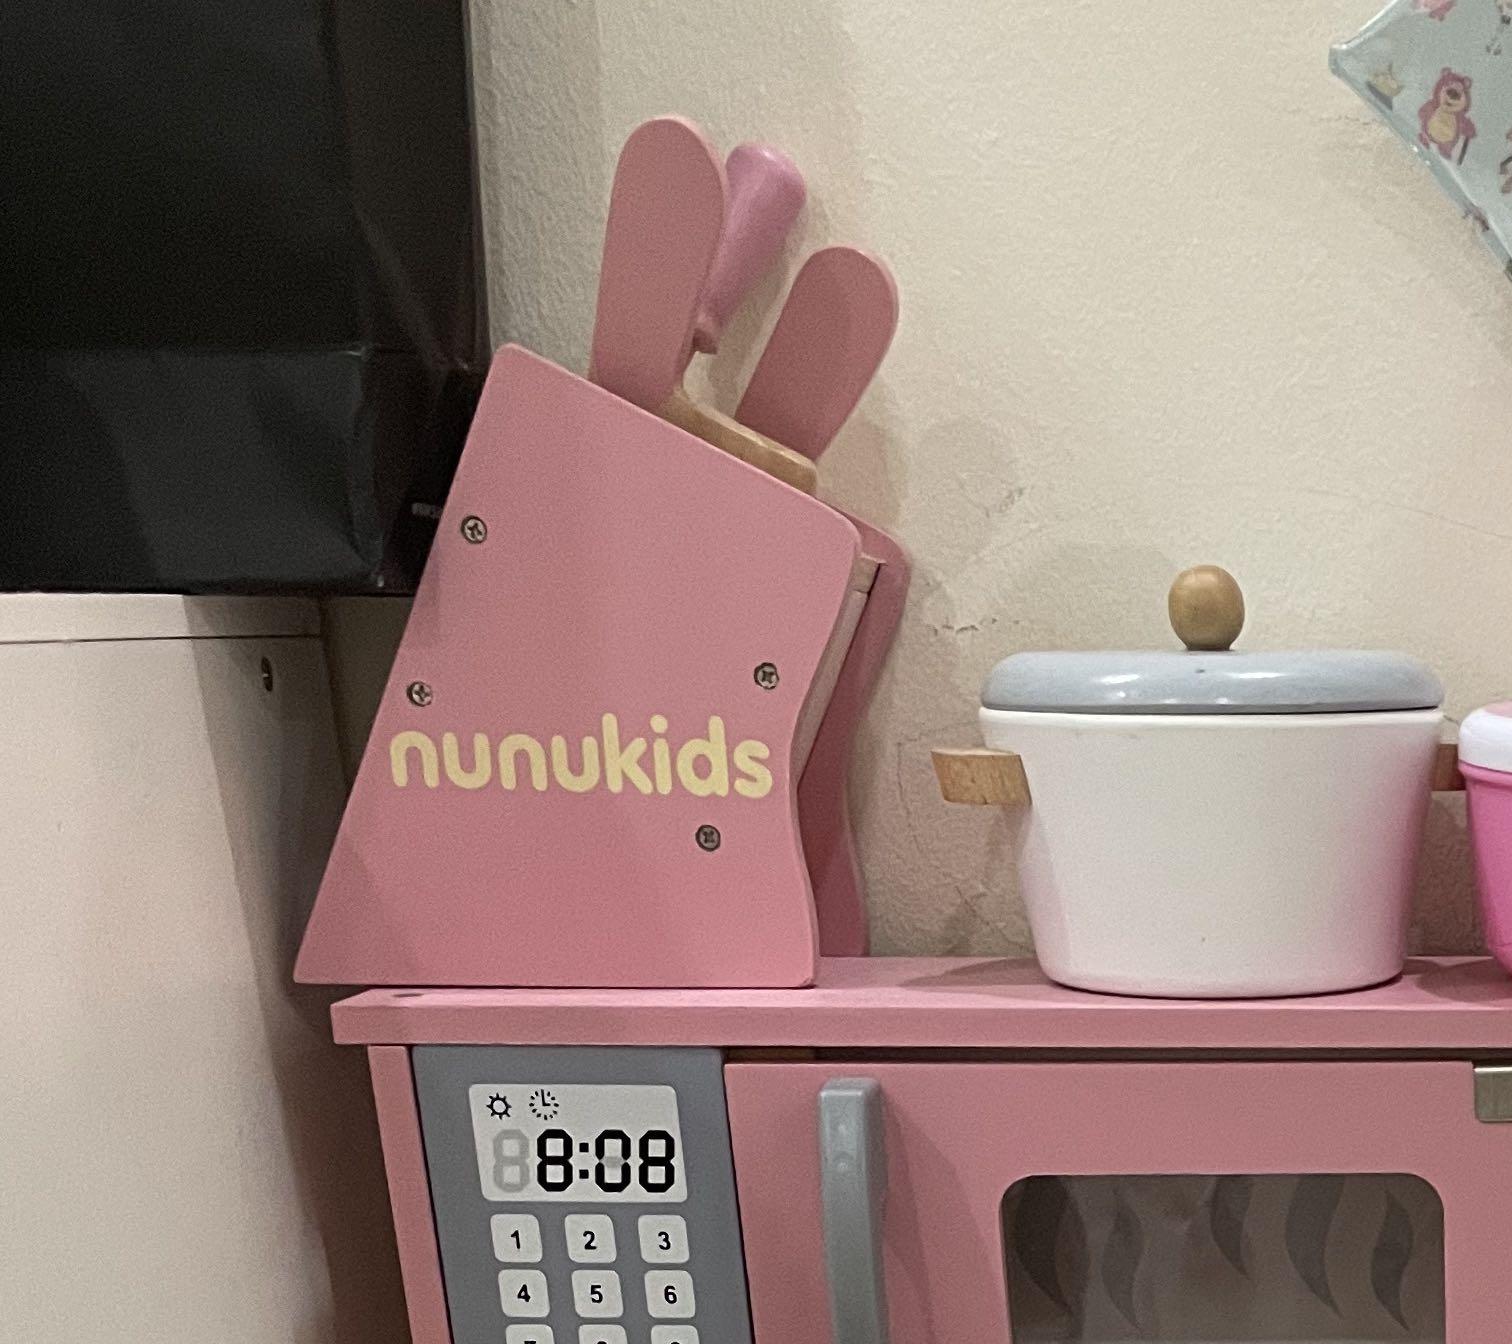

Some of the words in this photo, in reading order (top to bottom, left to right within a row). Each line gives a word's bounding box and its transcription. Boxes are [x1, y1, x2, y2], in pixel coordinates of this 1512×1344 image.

[389, 713, 773, 799] nunukids
[511, 1230, 521, 1249] 1
[583, 1231, 597, 1250] 2
[658, 1231, 671, 1250] 3
[517, 1284, 531, 1302] 4
[590, 1285, 603, 1303] 5
[664, 1286, 677, 1304] 6
